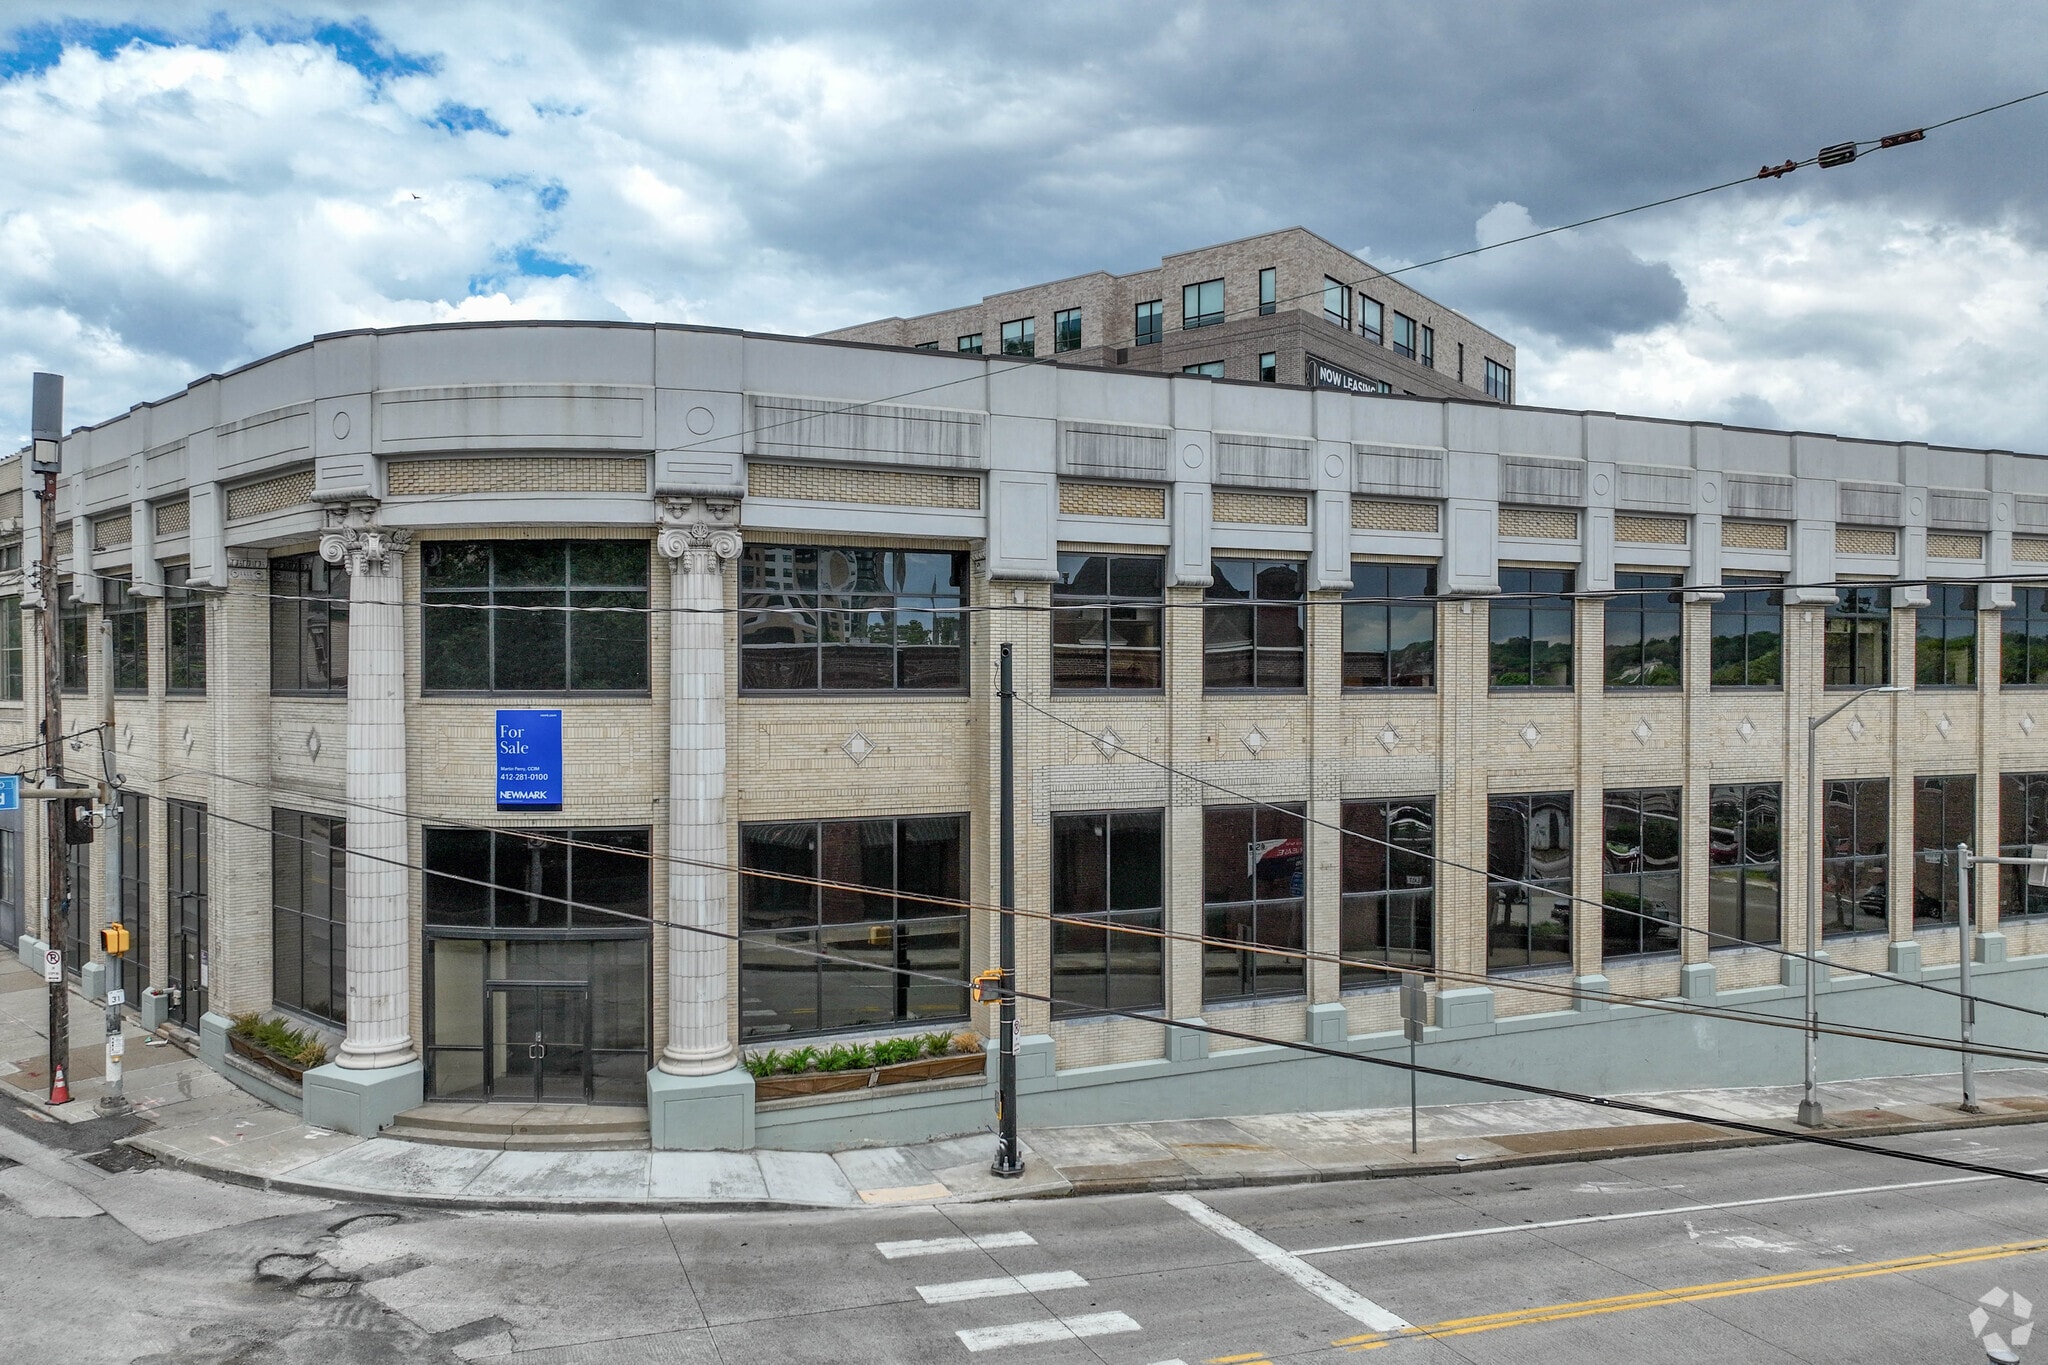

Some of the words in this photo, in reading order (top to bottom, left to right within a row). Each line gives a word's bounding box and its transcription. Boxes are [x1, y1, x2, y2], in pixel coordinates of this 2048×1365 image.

[1320, 366, 1342, 387] NOW
[500, 724, 525, 739] For
[500, 740, 529, 755] Sale
[500, 773, 549, 781] 412-281-0100
[500, 790, 548, 799] NEWMARK
[111, 995, 121, 1003] 31
